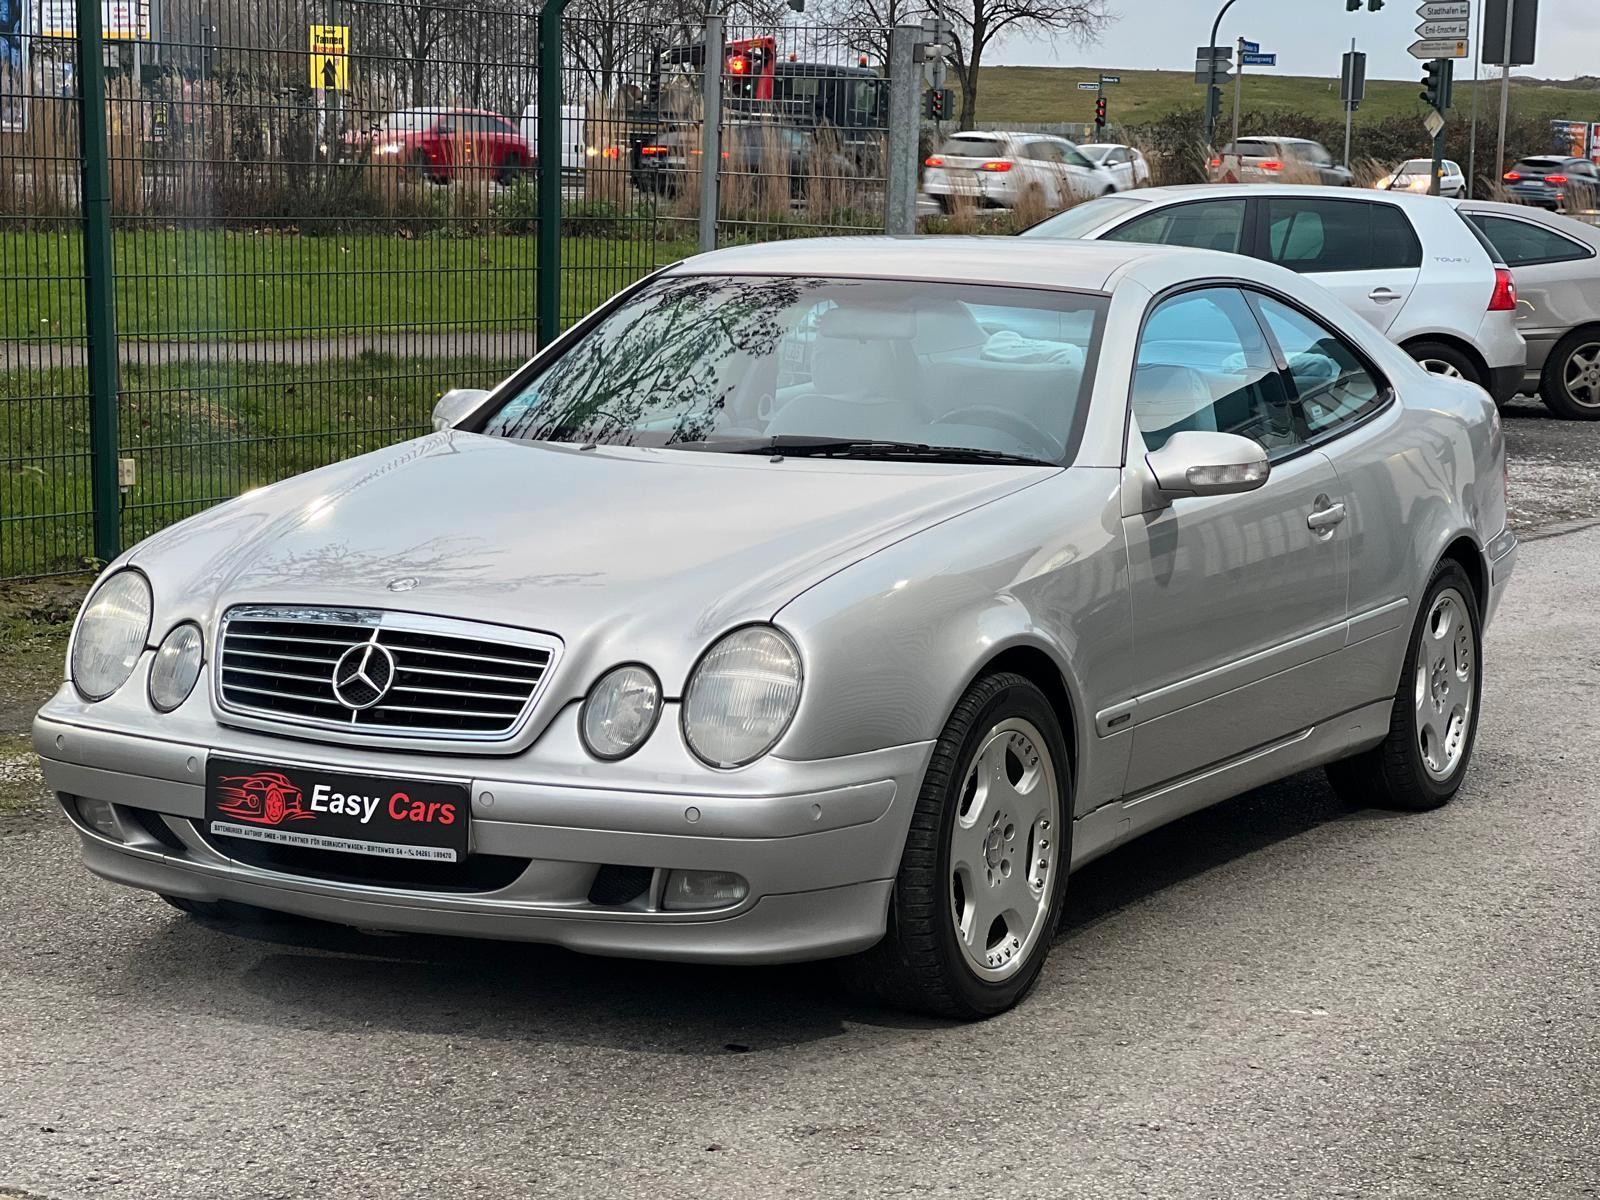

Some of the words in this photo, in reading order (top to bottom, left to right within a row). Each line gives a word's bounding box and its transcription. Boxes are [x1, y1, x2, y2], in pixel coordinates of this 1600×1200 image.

[1428, 6, 1459, 15] Stadthafen
[315, 35, 343, 45] Tannen
[310, 784, 381, 824] Easy
[388, 792, 456, 824] Cars
[288, 835, 309, 845] PARTNER
[310, 837, 320, 846] FÜR
